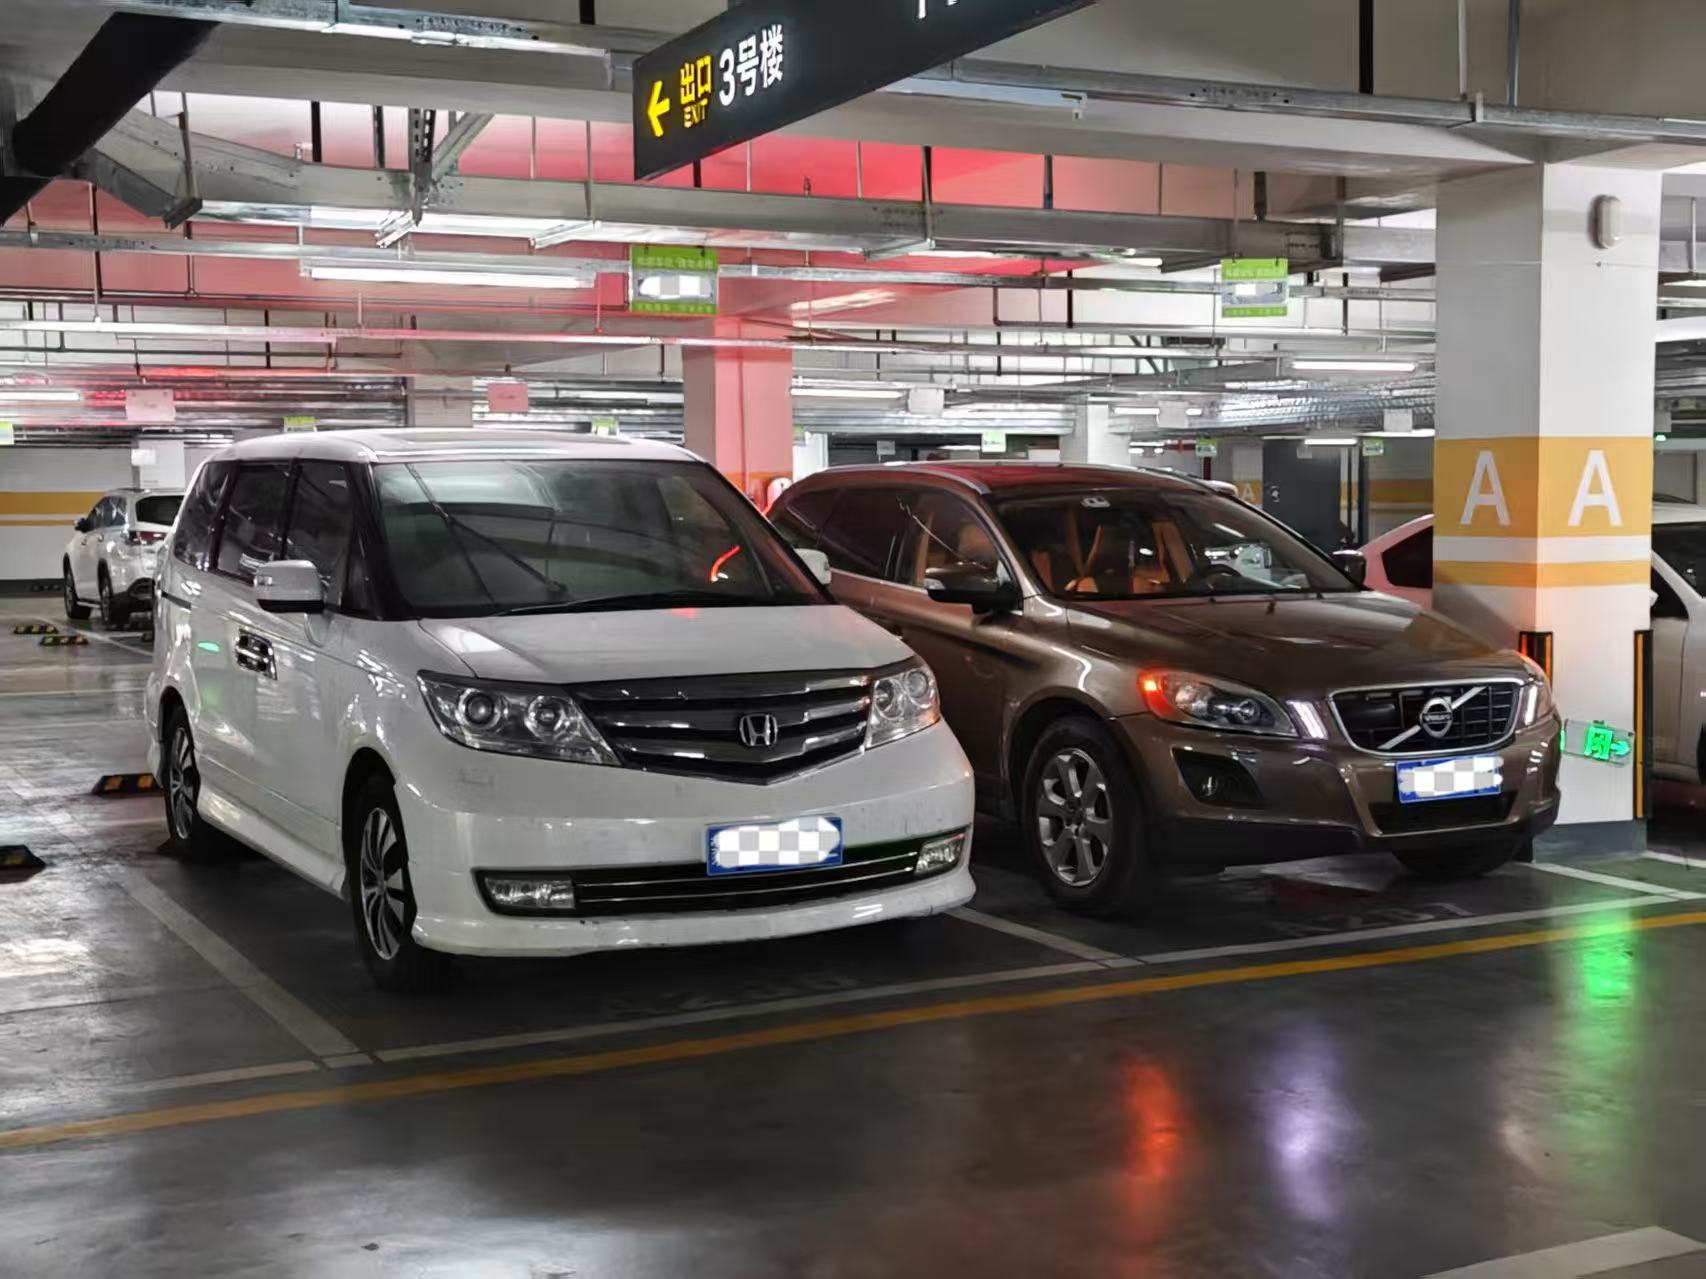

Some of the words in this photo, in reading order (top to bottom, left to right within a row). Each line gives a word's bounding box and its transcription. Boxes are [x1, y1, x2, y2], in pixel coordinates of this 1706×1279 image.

[681, 55, 711, 104] 出口
[720, 24, 783, 106] 3号楼
[1460, 450, 1511, 525] A
[1568, 450, 1623, 525] A
